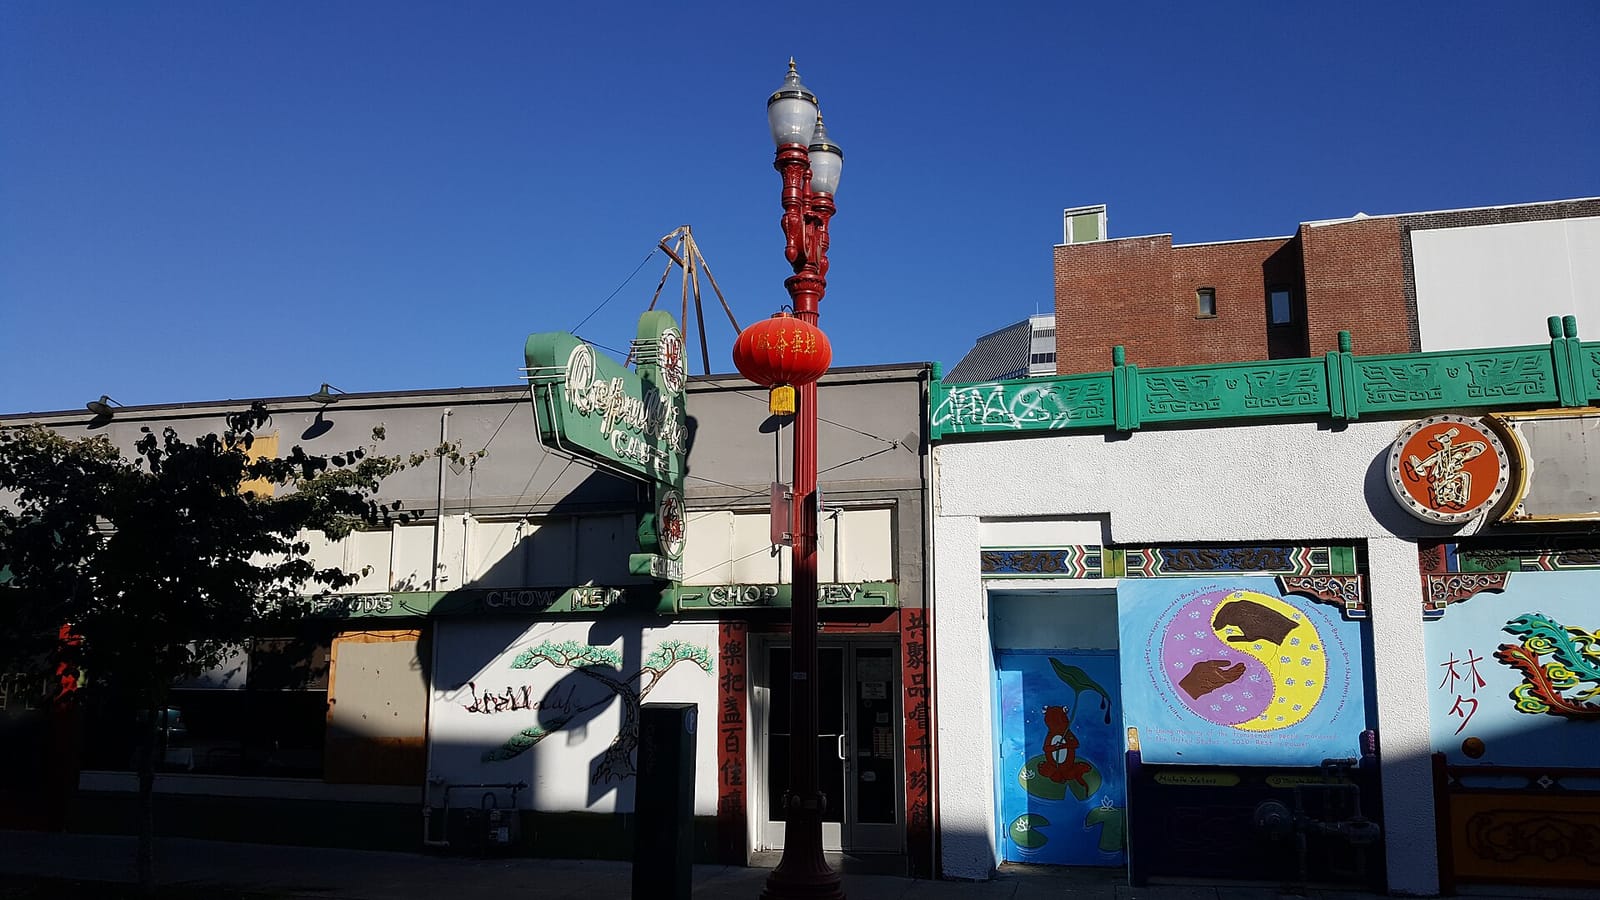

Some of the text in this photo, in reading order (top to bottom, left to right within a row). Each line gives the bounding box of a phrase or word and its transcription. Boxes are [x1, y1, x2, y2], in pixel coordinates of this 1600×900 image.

[611, 430, 670, 471] CAFE
[650, 556, 683, 580] COCKTAILS
[486, 587, 626, 608] CHOW MEIN
[708, 584, 779, 605] CHOP
